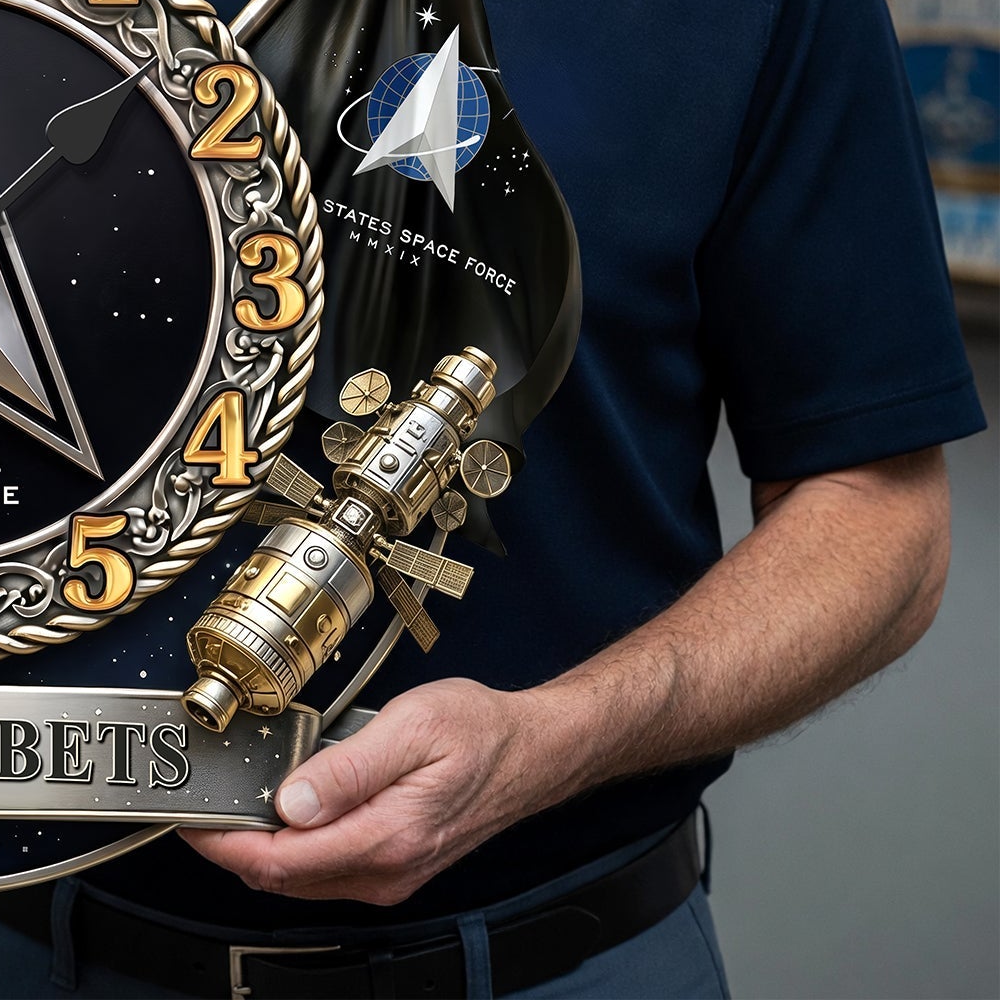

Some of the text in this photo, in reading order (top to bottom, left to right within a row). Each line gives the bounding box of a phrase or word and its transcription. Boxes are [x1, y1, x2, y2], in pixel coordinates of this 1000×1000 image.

[188, 61, 264, 162] 2
[232, 230, 305, 332] 3
[322, 199, 517, 296] STATES SPACE FORCE
[181, 387, 263, 488] 4
[61, 511, 137, 612] 5
